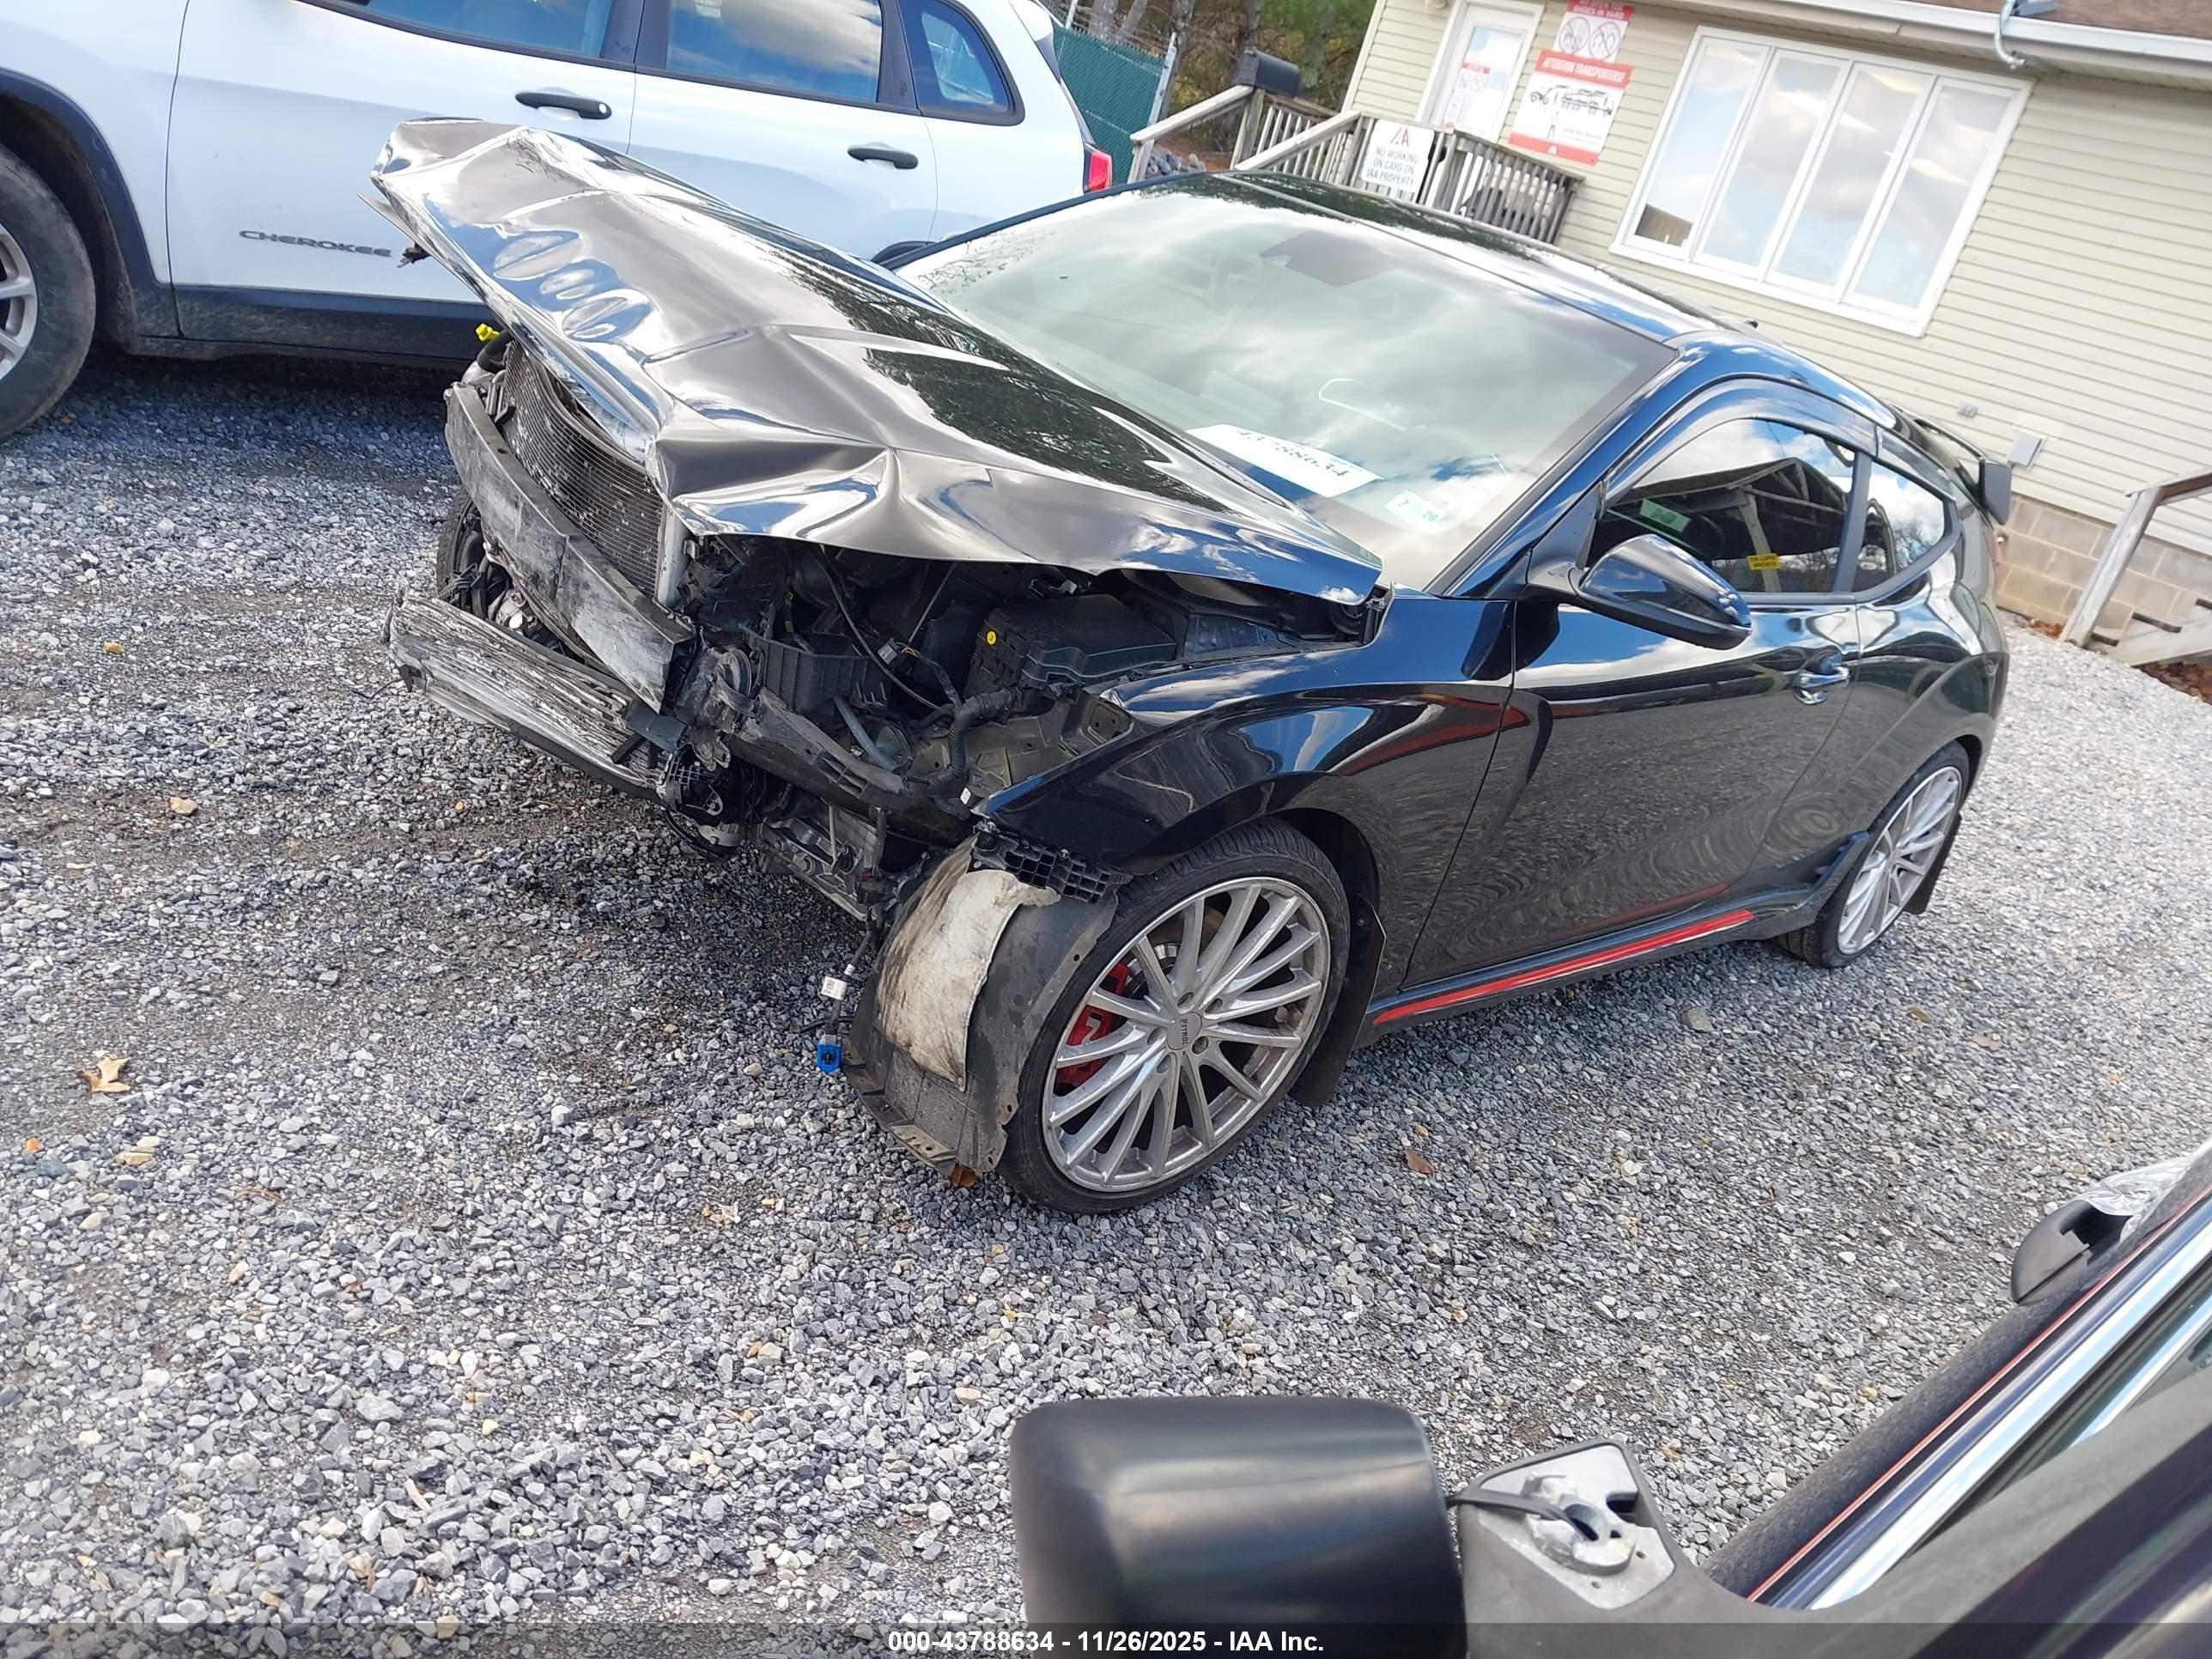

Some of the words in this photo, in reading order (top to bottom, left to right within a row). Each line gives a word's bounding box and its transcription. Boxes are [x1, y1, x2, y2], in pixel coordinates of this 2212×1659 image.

[1376, 146, 1387, 156] NO
[1387, 149, 1419, 164] WORKING
[1373, 156, 1383, 168] ON
[1384, 159, 1403, 173] CARS
[1404, 164, 1415, 175] ON
[1366, 167, 1379, 179] IAA
[1379, 170, 1414, 186] PROPERTY
[239, 229, 392, 258] CHEROKEE
